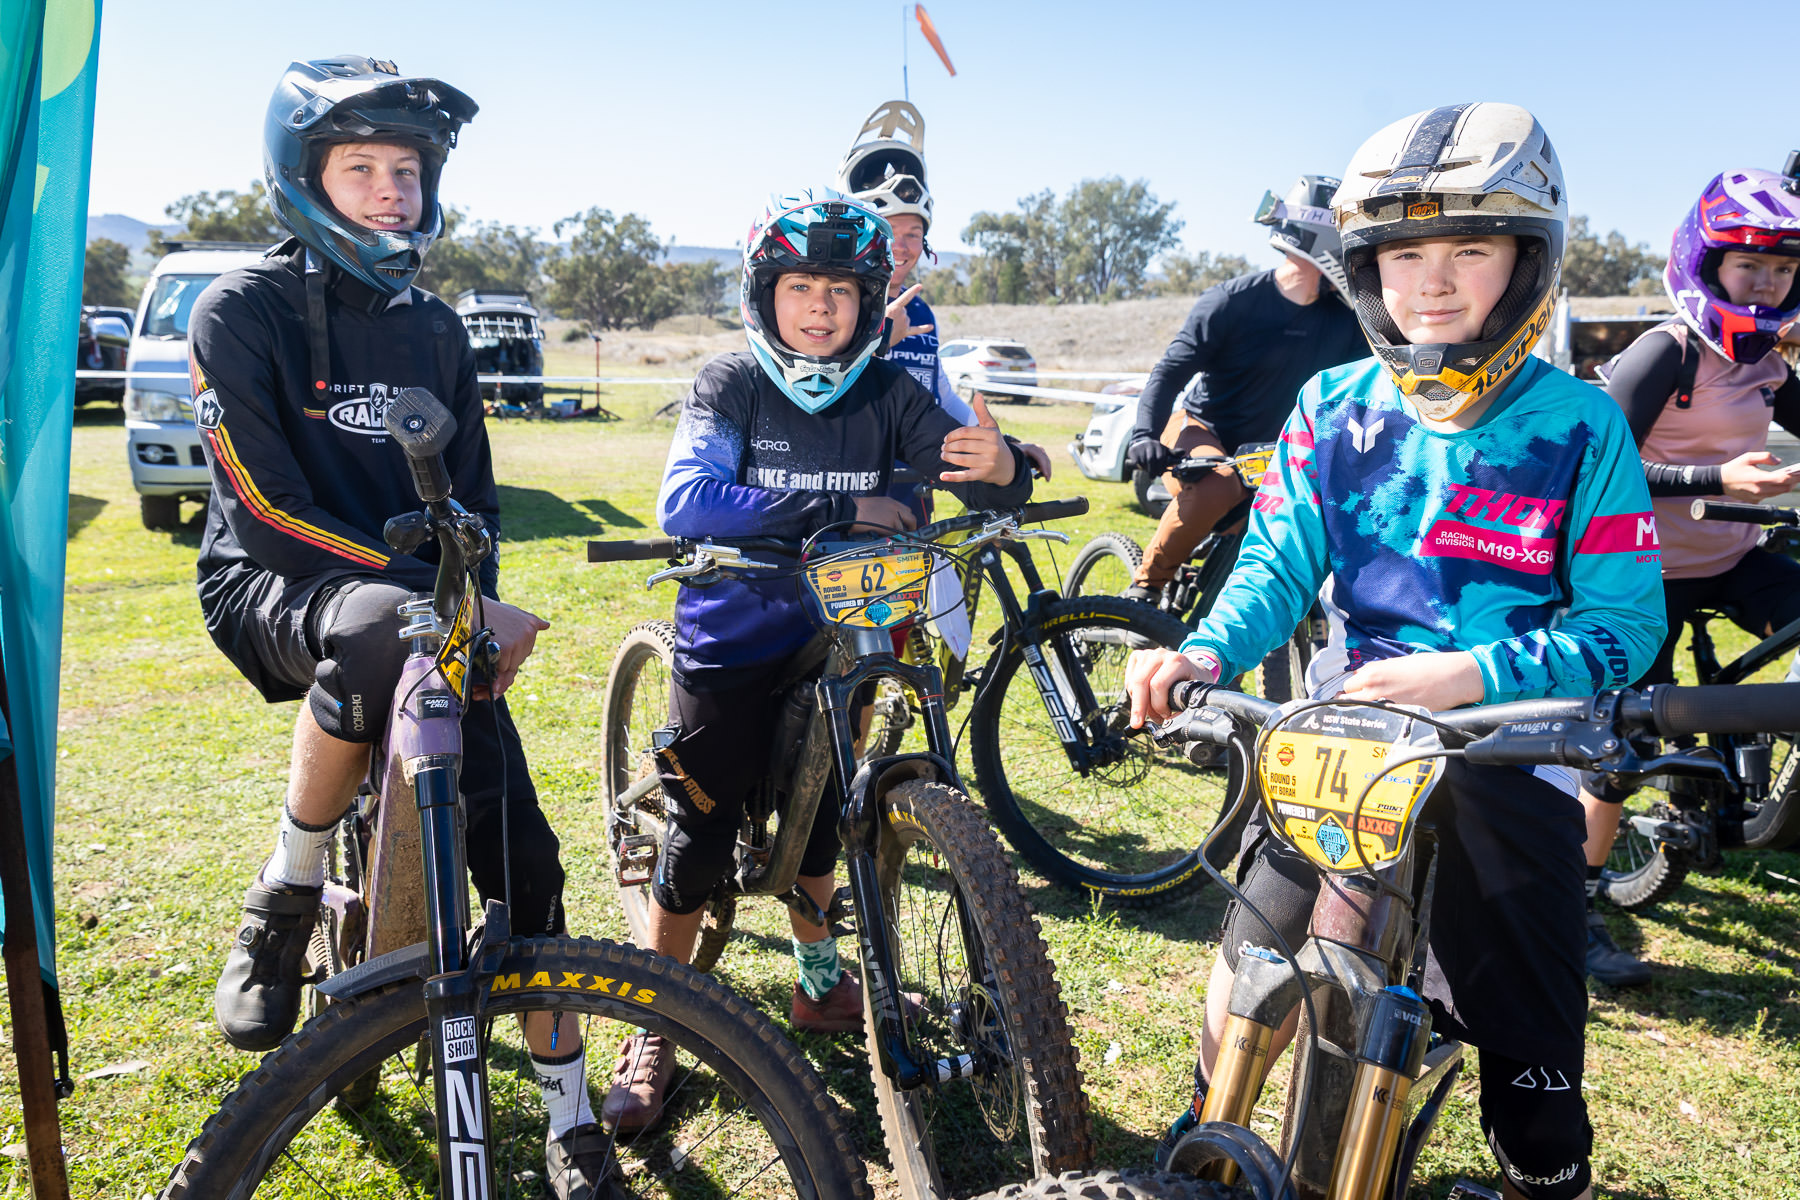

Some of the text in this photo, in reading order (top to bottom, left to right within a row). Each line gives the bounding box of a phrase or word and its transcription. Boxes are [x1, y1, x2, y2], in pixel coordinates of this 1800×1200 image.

[1412, 205, 1435, 216] 100%
[329, 384, 365, 394] RIFT
[746, 466, 880, 491] BIKE and FITNES
[1444, 483, 1567, 530] THOR
[1435, 537, 1475, 549] DIVISION
[1440, 531, 1475, 543] RACING
[896, 555, 919, 563] SMITH
[861, 562, 887, 593] 62
[888, 592, 920, 601] MAXXIS
[830, 600, 857, 609] POWERED
[1031, 665, 1078, 743] ZEB
[1323, 714, 1388, 730] NSW State Series
[1511, 722, 1549, 733] MAVEN
[1270, 772, 1296, 786] ROUND 5
[1315, 746, 1348, 803] 74
[1364, 772, 1412, 785] OBEA
[682, 778, 716, 815] FITNESS
[1270, 785, 1296, 797] MT BORAH
[1277, 802, 1316, 820] POWERED BY
[1376, 803, 1404, 812] POINT
[1346, 815, 1396, 836] MAXXIS
[1320, 829, 1343, 843] GRAVITY
[1118, 868, 1193, 897] SCORPION
[490, 971, 657, 1004] MAXXIS
[446, 1020, 474, 1040] ROCK
[447, 1040, 475, 1058] SHOX
